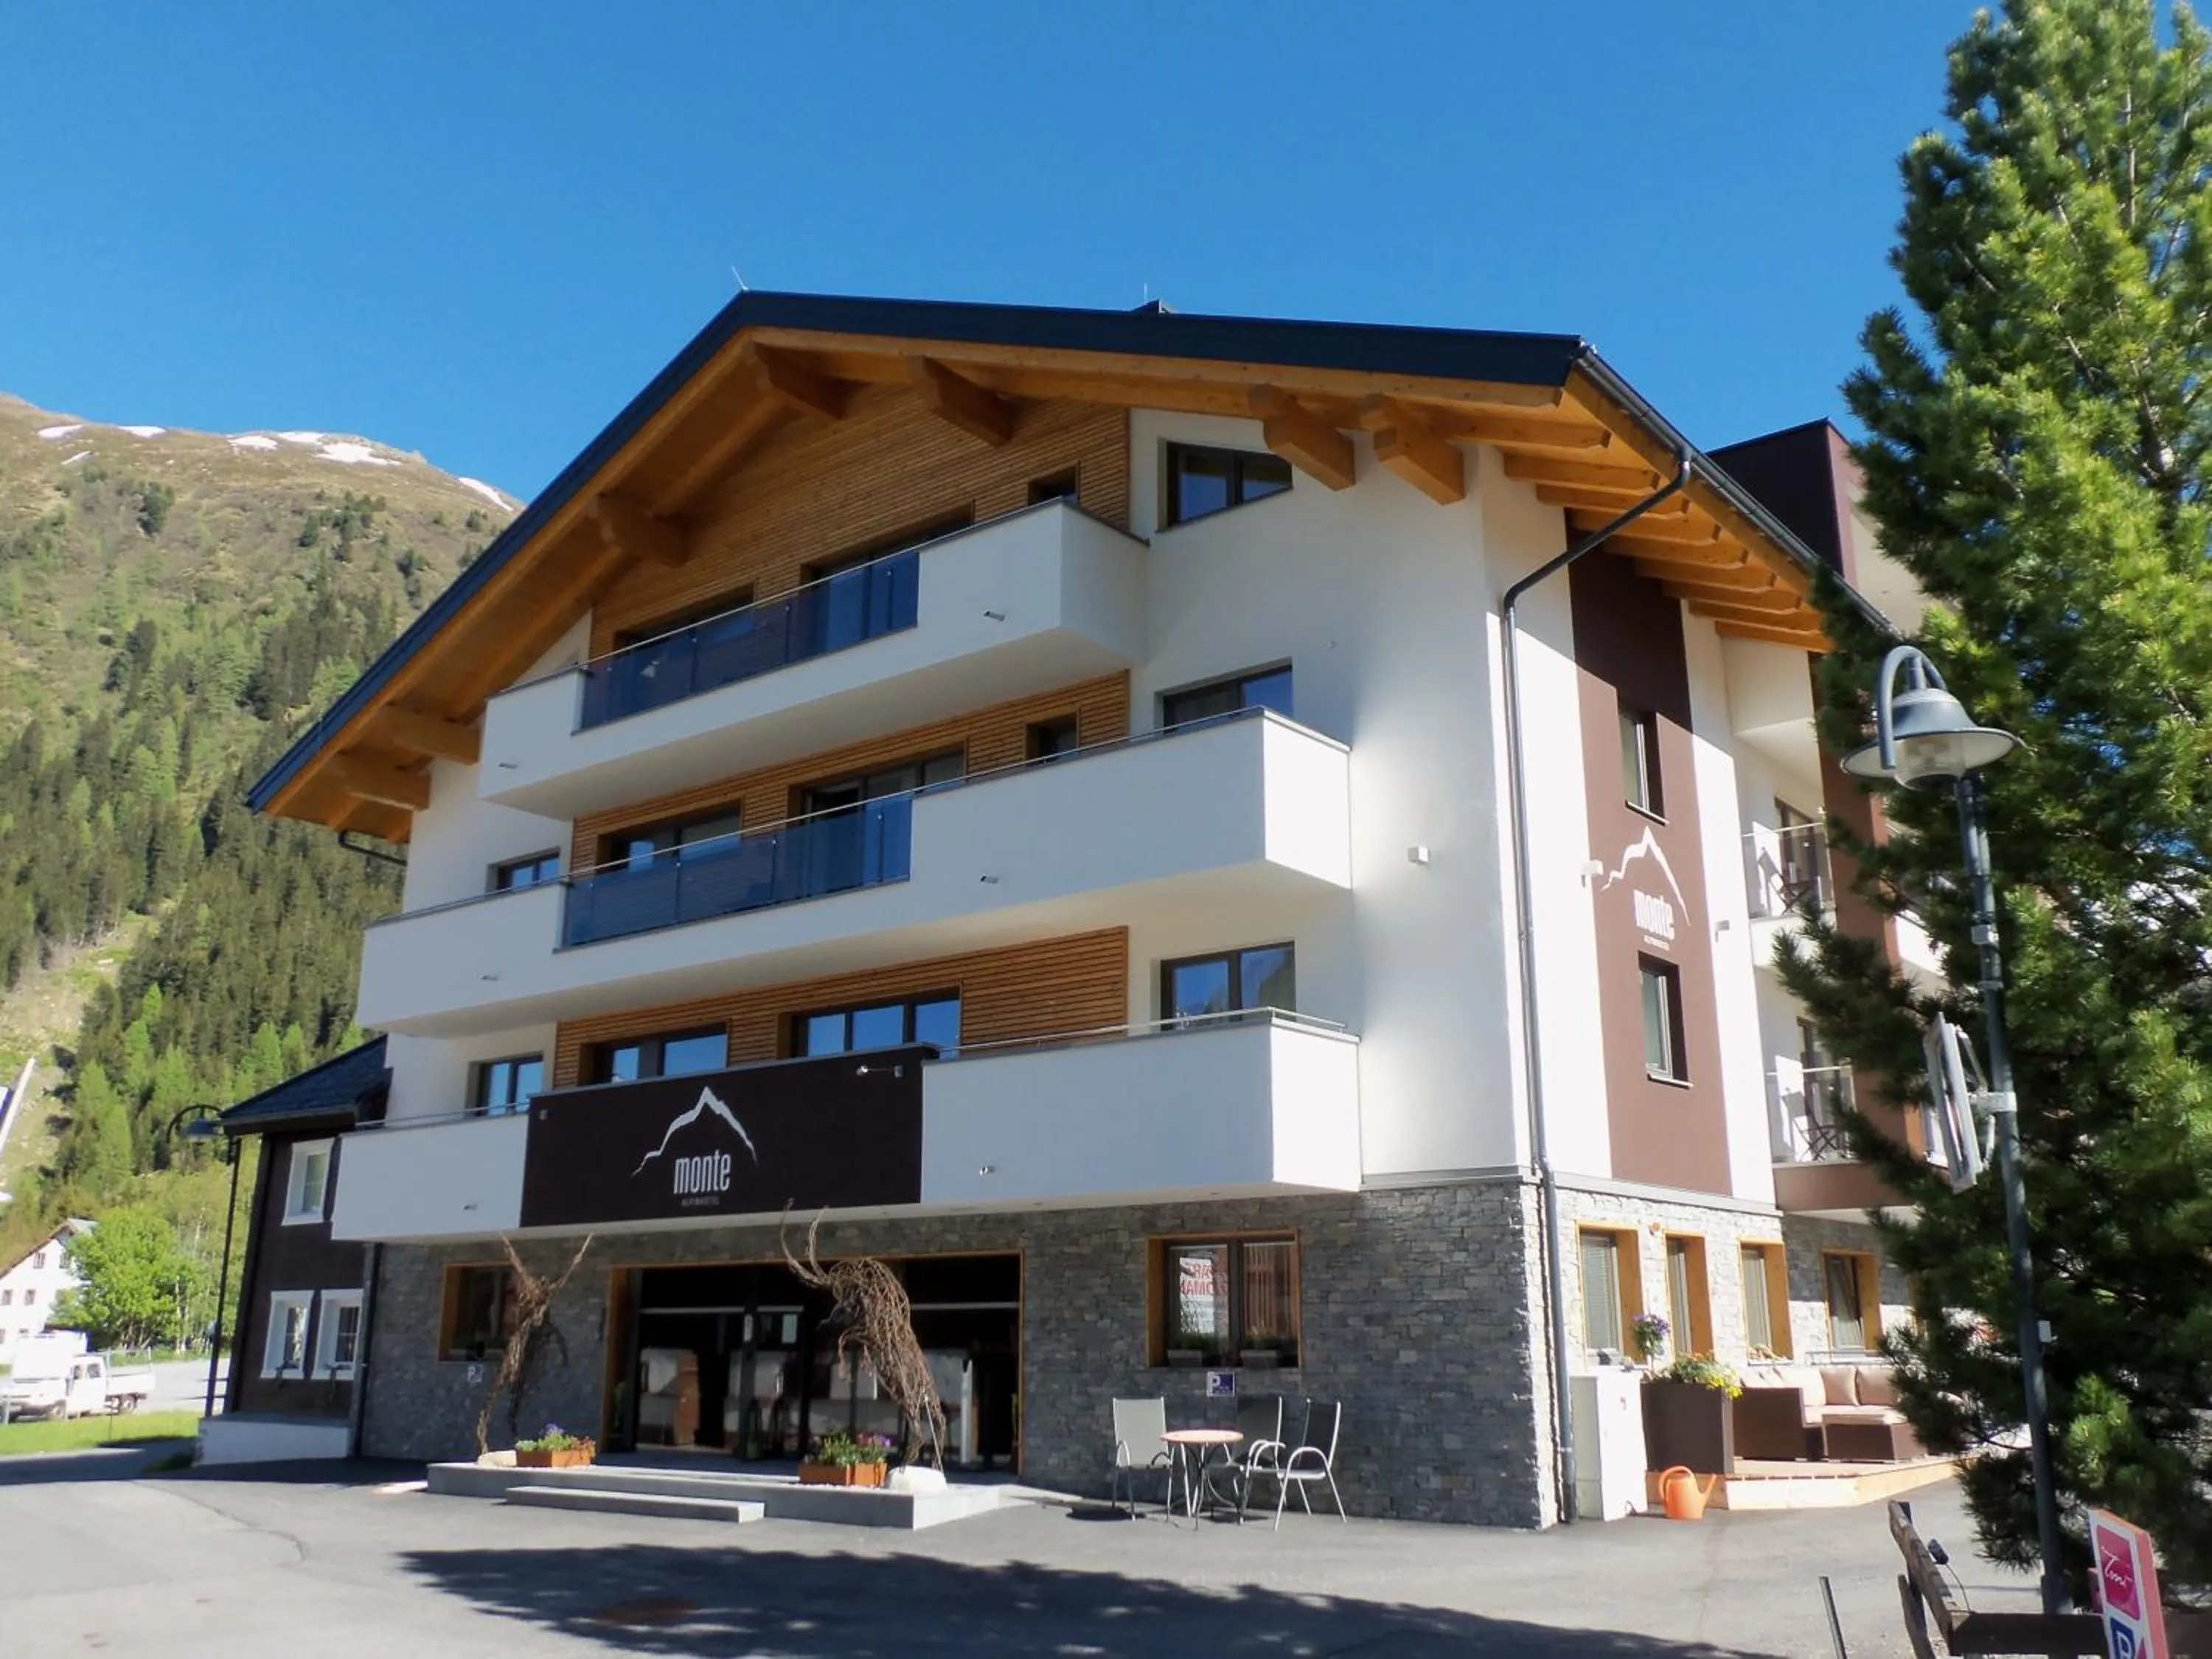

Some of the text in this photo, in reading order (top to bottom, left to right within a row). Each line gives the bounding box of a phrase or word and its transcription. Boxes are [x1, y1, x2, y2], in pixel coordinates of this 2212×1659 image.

[1633, 889, 1675, 940] monte
[673, 1149, 731, 1195] monte
[1208, 1374, 1221, 1395] P
[2116, 1630, 2134, 1659] P
